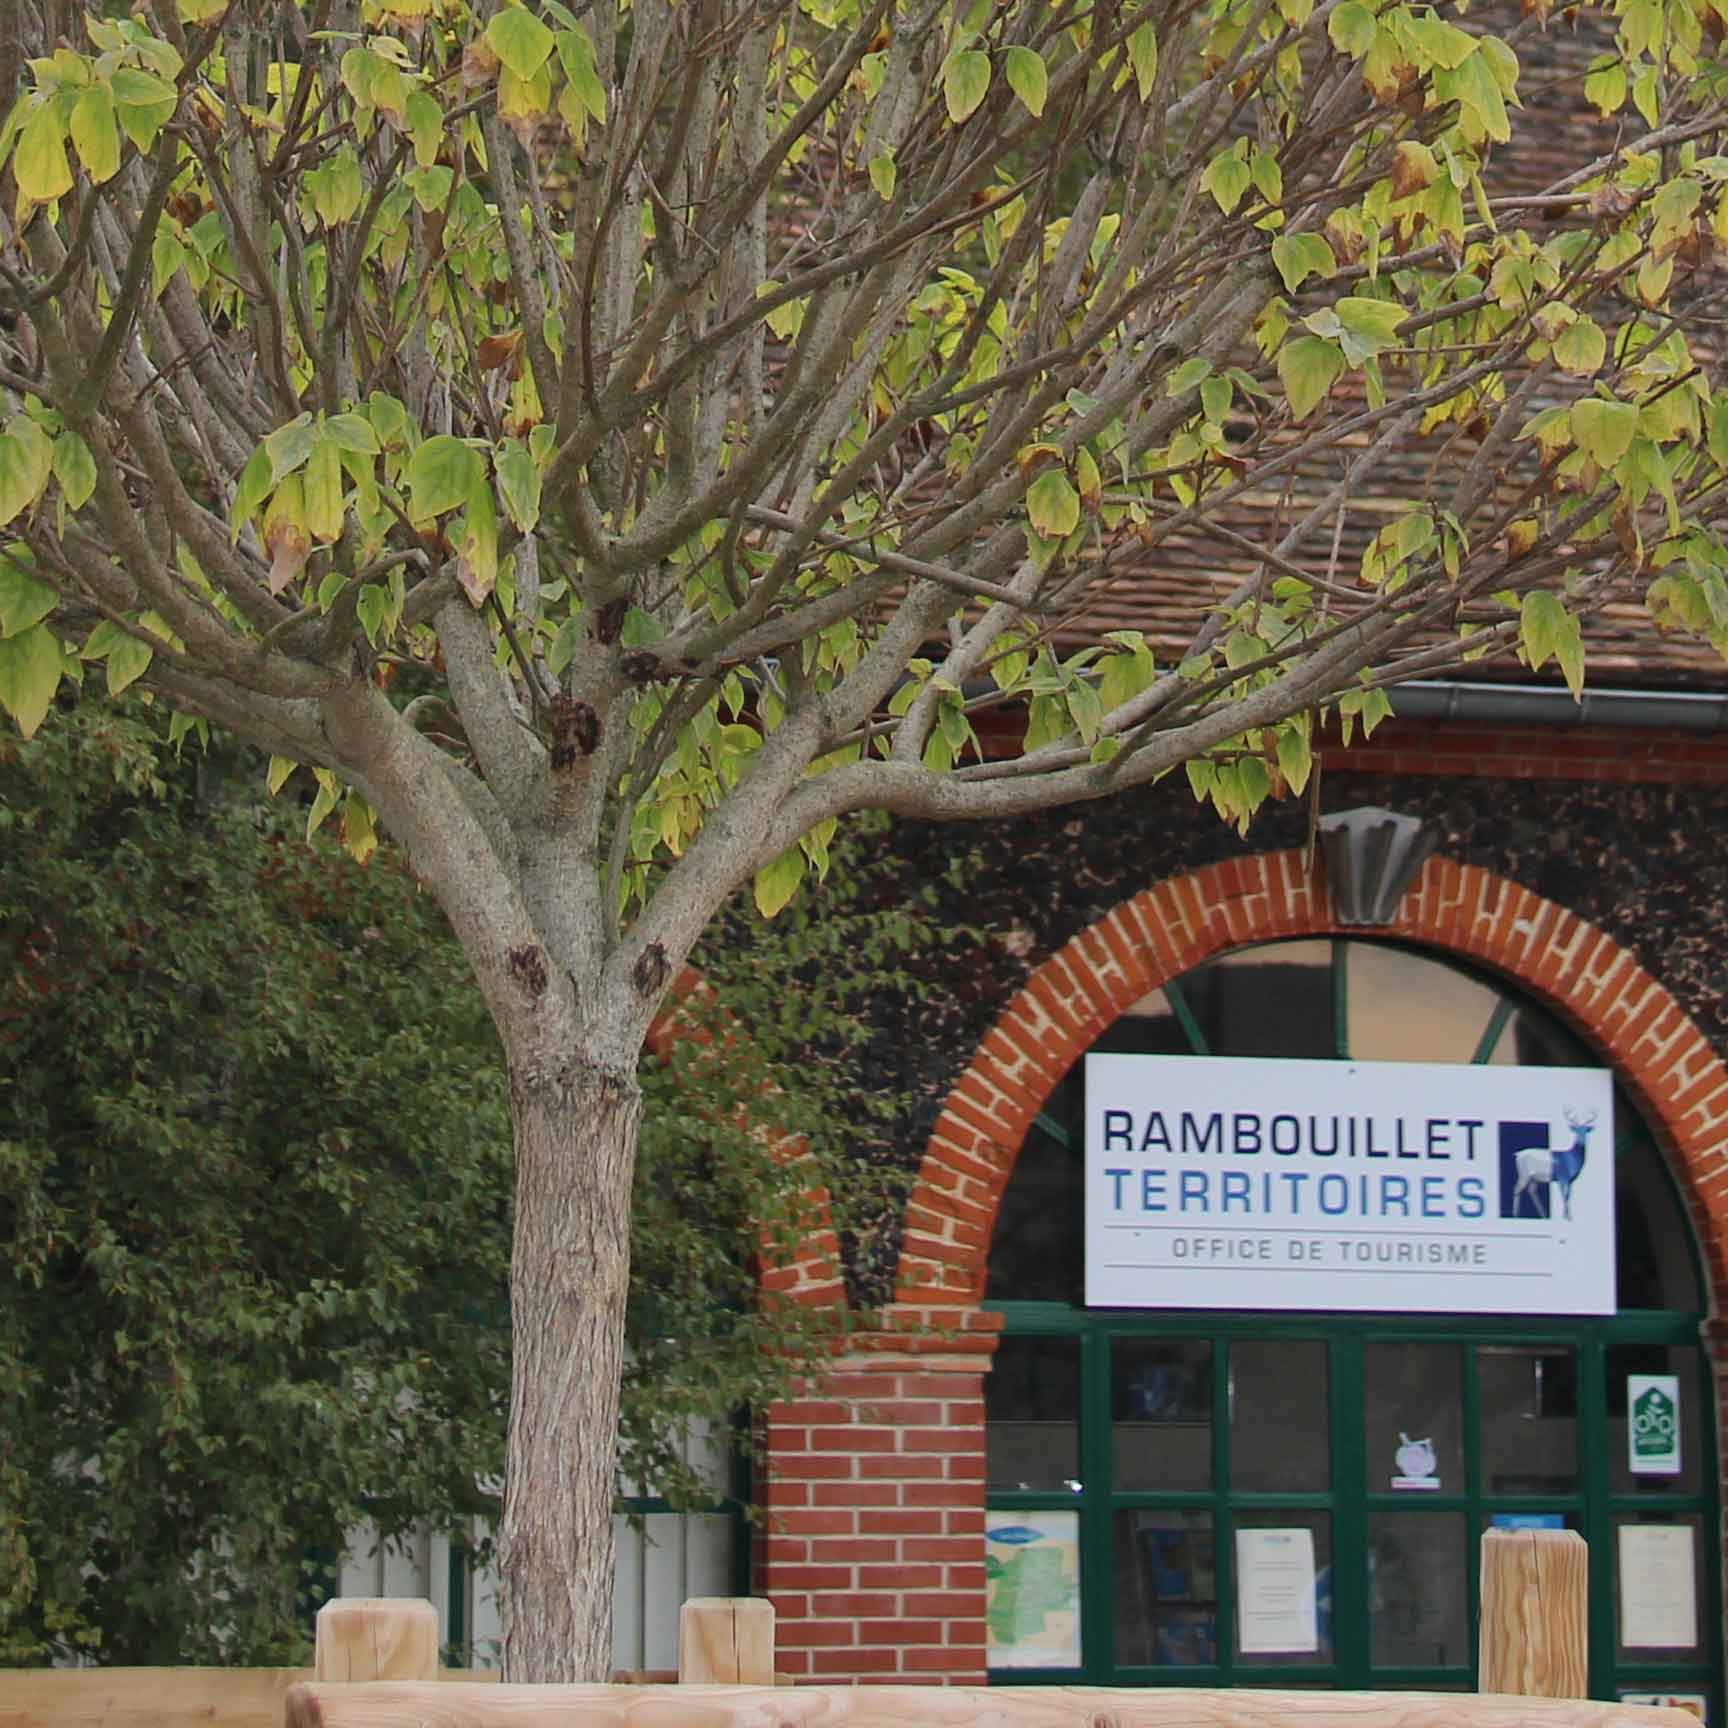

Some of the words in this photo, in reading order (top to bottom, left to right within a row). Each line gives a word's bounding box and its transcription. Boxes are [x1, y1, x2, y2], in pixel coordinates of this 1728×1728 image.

[1103, 1110, 1485, 1160] RAMBOUILLET
[1105, 1169, 1486, 1218] TERRITOIRES
[1172, 1238, 1273, 1260] OFFICE
[1288, 1240, 1323, 1261] DE
[1339, 1241, 1487, 1264] TOURISME
